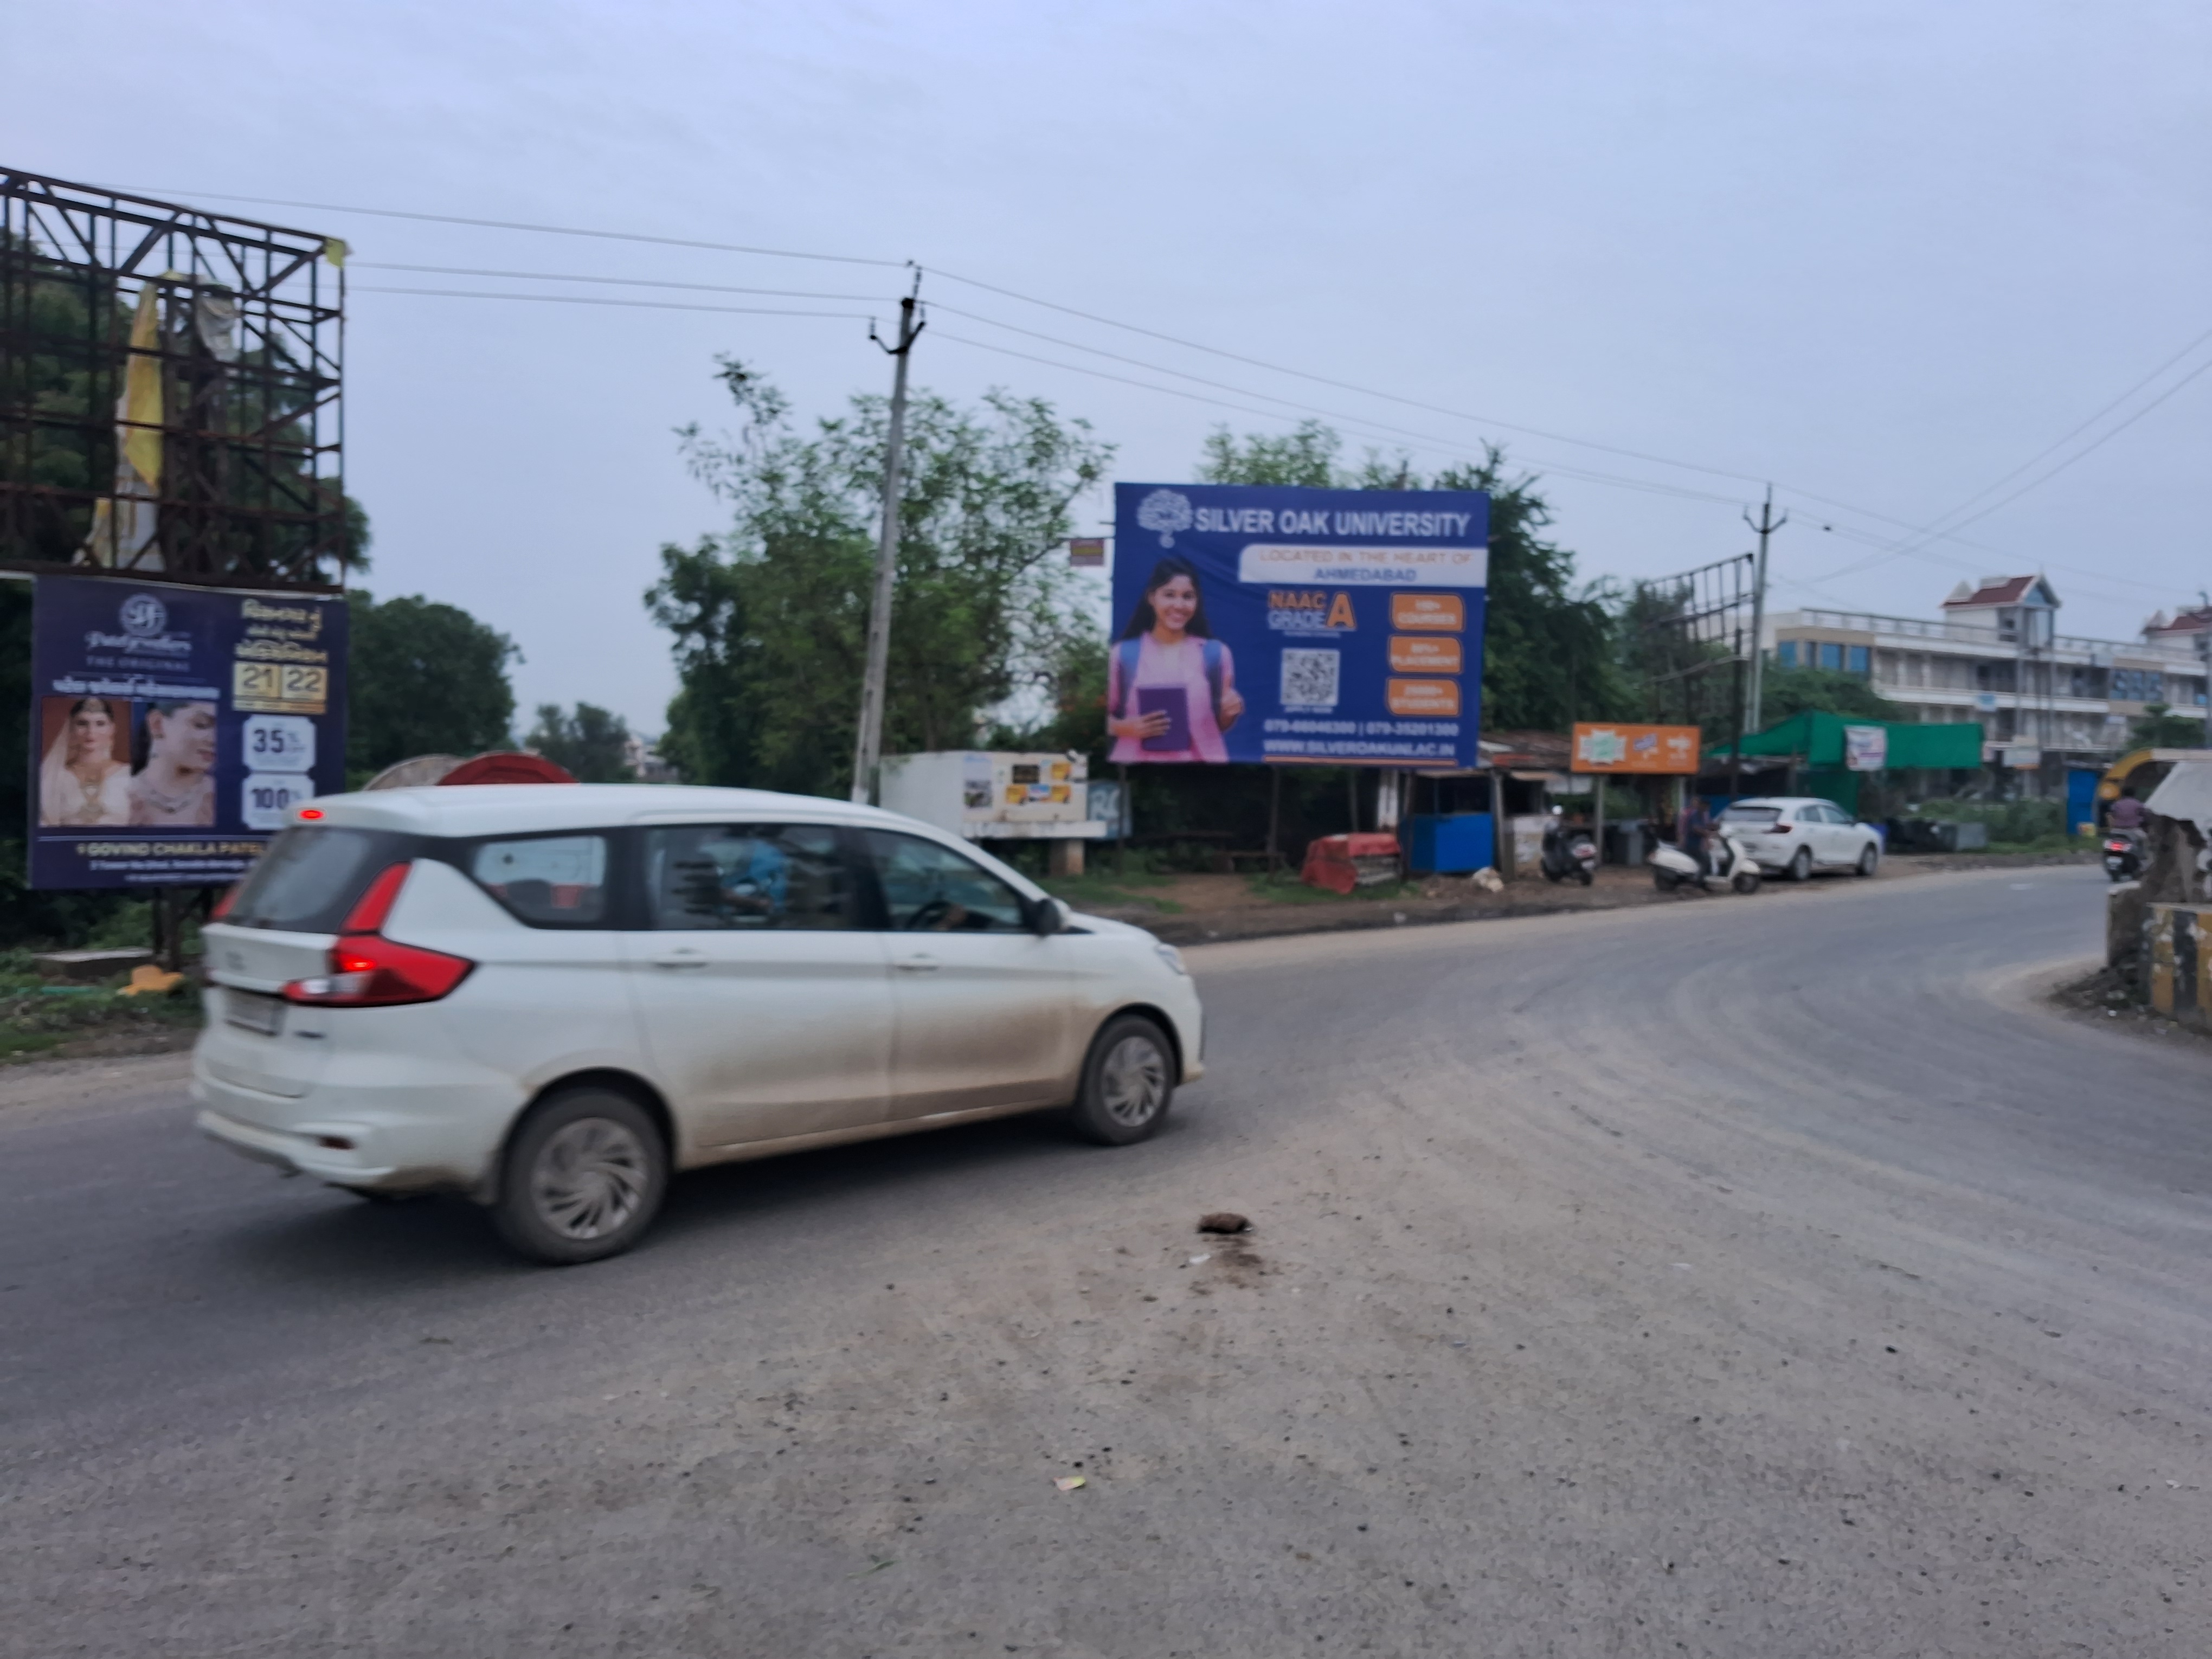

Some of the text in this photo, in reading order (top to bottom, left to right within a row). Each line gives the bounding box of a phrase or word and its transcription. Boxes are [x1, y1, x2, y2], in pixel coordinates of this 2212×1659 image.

[1195, 507, 1472, 537] SILVER OAK UNIVERSITY
[1259, 549, 1473, 564] LOCATED IN THE HEART OF
[1314, 568, 1417, 582] AHMEDABAD
[1269, 591, 1326, 608] NAAC
[1327, 591, 1356, 627] A
[1268, 610, 1326, 627] GRADE
[243, 666, 273, 689] 21
[287, 668, 321, 692] 22
[253, 729, 284, 753] 35
[252, 789, 290, 809] 100
